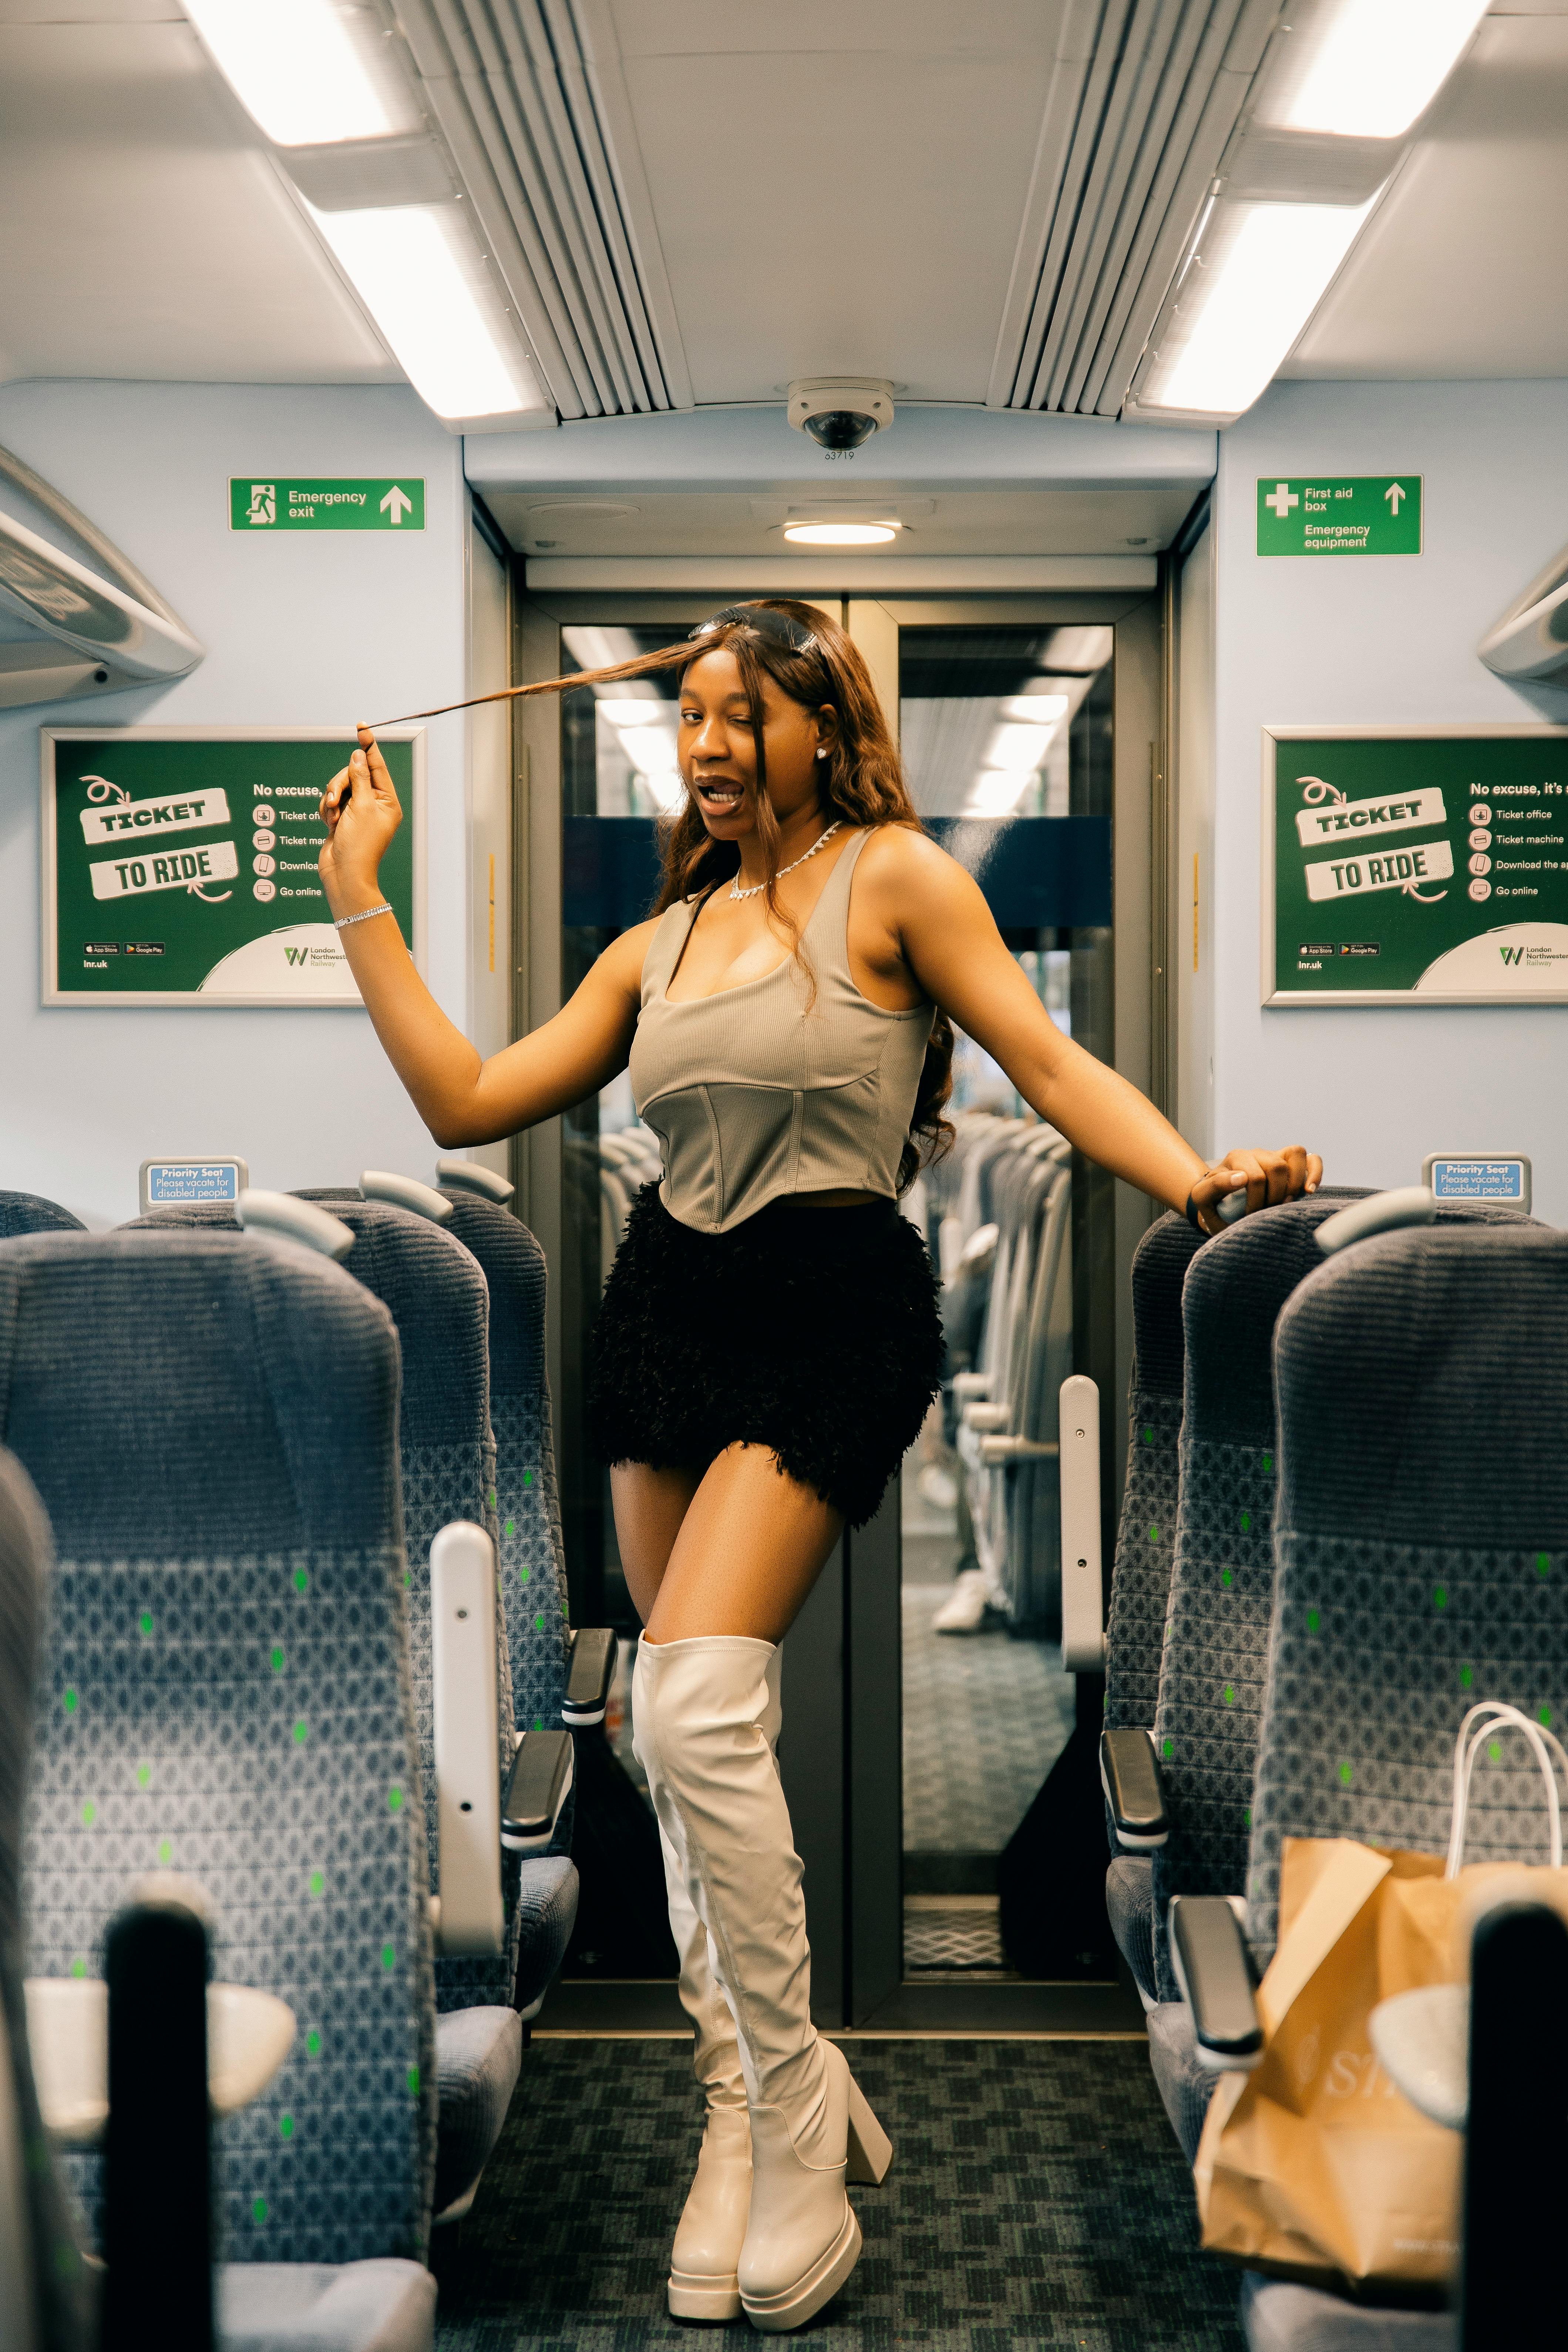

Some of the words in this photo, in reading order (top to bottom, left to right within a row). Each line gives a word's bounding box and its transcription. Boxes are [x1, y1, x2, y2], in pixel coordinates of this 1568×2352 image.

[825, 451, 854, 460] 63719
[289, 491, 367, 505] Emergency
[1305, 488, 1331, 498] First
[1335, 488, 1353, 498] aid
[1305, 501, 1327, 511] box
[289, 506, 314, 517] exit
[1305, 525, 1370, 537] Emergency
[1305, 537, 1367, 549] equipment
[253, 784, 272, 795] No
[275, 787, 323, 797] excuse,
[1471, 783, 1490, 794] No
[1493, 785, 1541, 796] excuse,
[100, 799, 205, 832] TICKET
[279, 811, 307, 820] Ticket
[1315, 799, 1423, 832] TICKET
[1496, 810, 1524, 819] Ticket
[1526, 810, 1552, 819] office
[279, 836, 307, 844] Ticket
[1496, 835, 1524, 844] Ticket
[1526, 834, 1564, 844] machine
[1496, 860, 1541, 869] Download
[1544, 860, 1558, 868] the
[114, 861, 147, 890] TO
[152, 850, 212, 885] RIDE
[1331, 861, 1363, 890] TO
[1369, 850, 1429, 885] RIDE
[280, 887, 294, 896] Go
[296, 887, 322, 895] online
[1496, 886, 1510, 895] Go
[1512, 886, 1538, 895] online
[84, 960, 107, 968] lnr.uk
[162, 1168, 199, 1179] Priority
[202, 1168, 223, 1177] Seat
[1446, 1165, 1484, 1175] Priority
[1487, 1165, 1509, 1174] Seat
[157, 1178, 184, 1187] Please
[217, 1177, 229, 1186] for
[1440, 1174, 1469, 1184] Please
[1471, 1175, 1500, 1184] vacate
[1502, 1174, 1514, 1183] for
[158, 1187, 195, 1197] disabled
[198, 1187, 228, 1199] people
[1442, 1184, 1480, 1194] disabled
[1483, 1184, 1513, 1196] people
